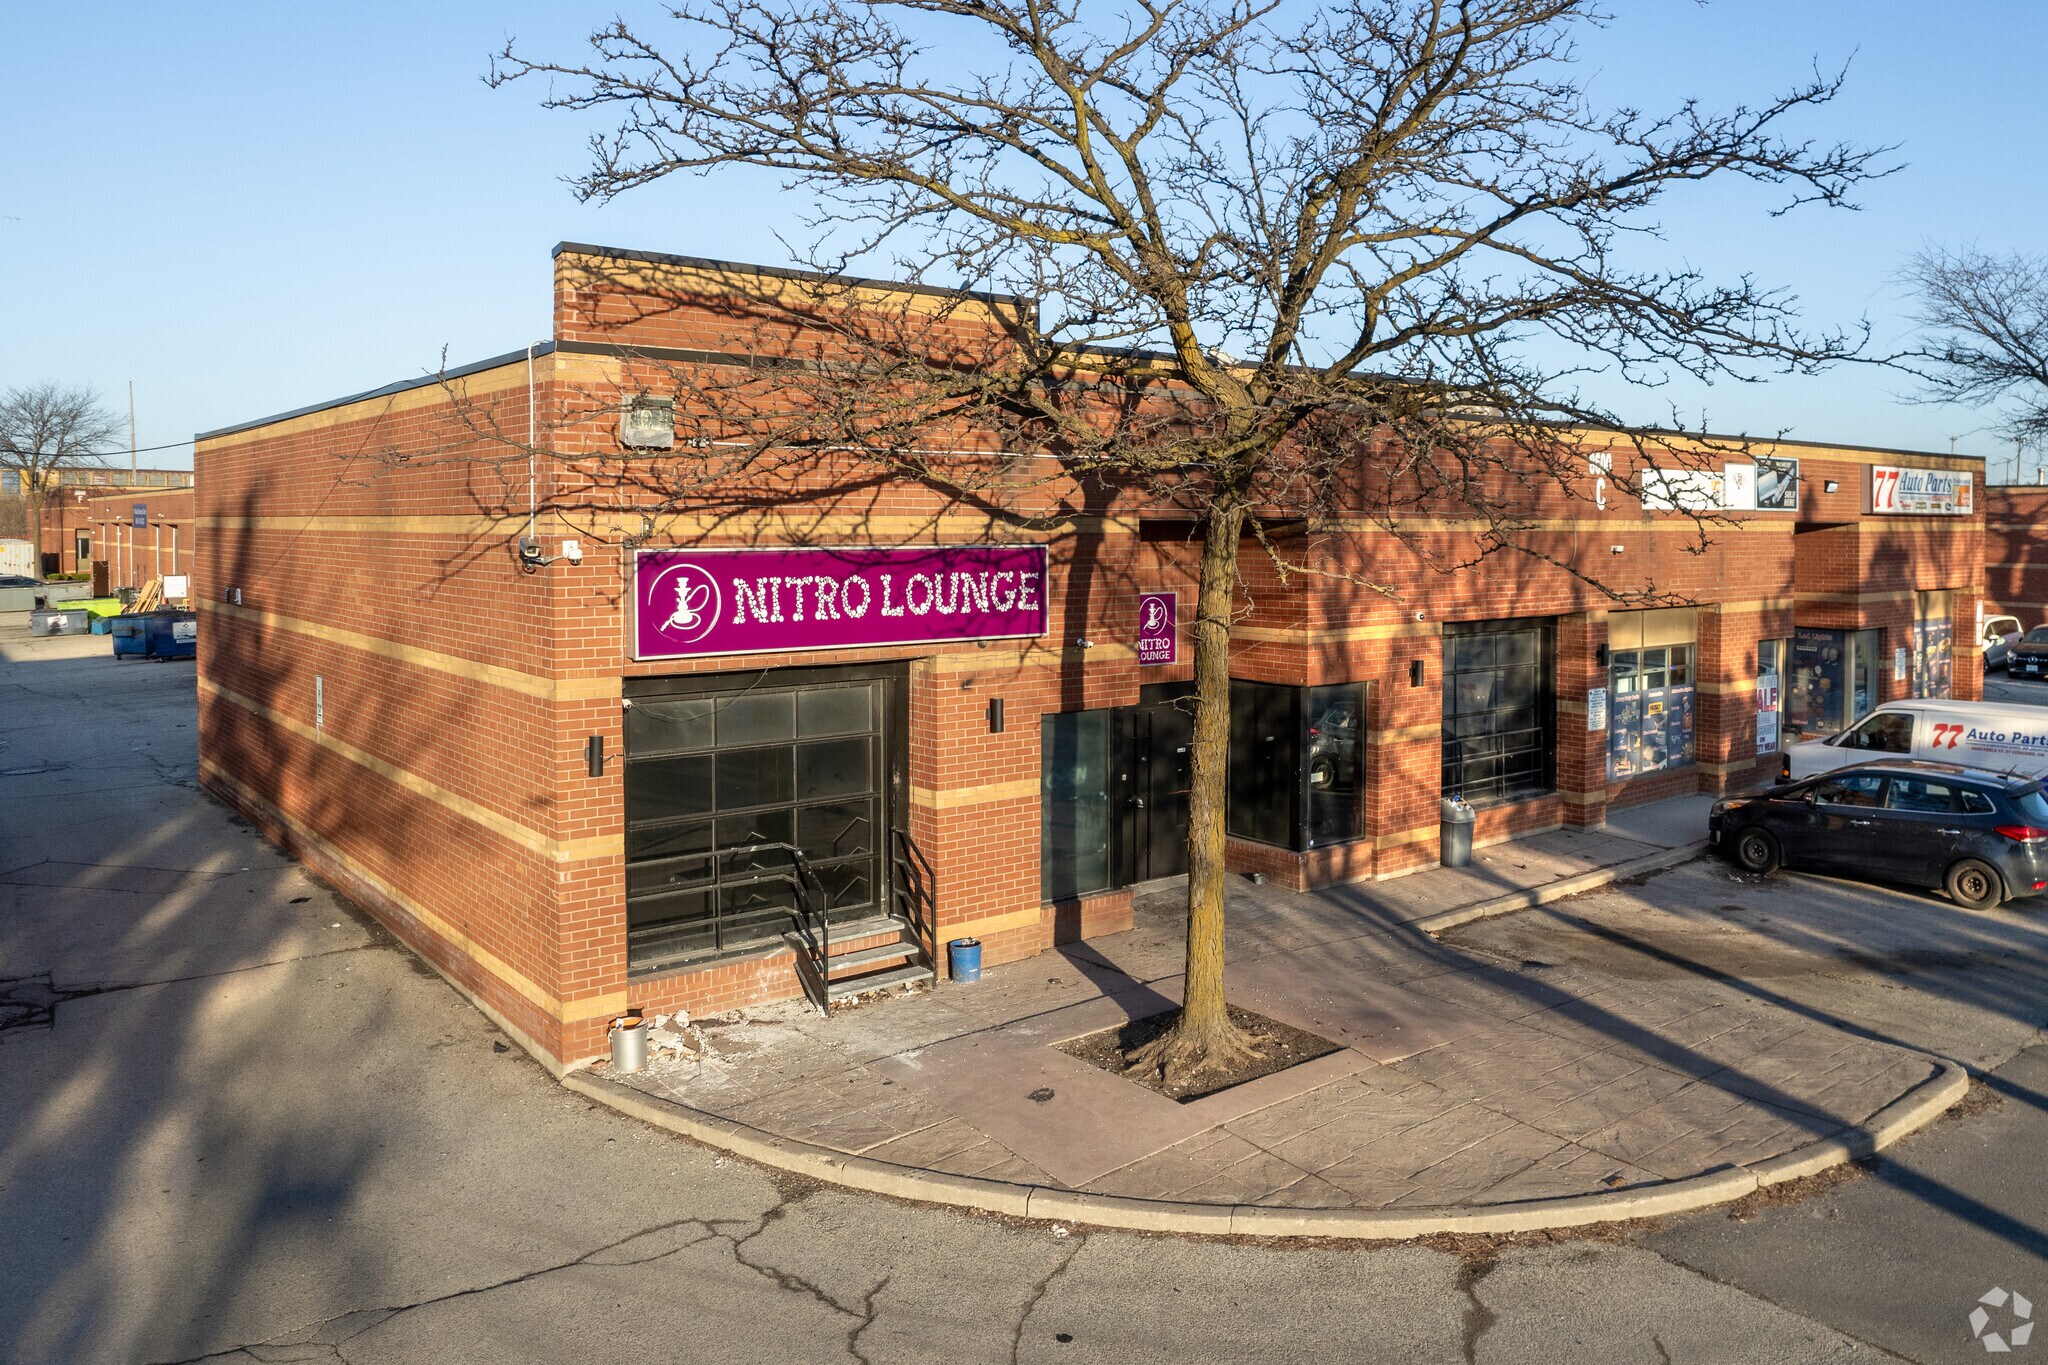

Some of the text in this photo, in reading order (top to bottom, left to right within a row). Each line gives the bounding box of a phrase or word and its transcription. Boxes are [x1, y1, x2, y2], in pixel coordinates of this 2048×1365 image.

[1596, 477, 1606, 510] C
[1875, 470, 1899, 508] 77
[1899, 472, 1923, 492] Auto
[1925, 473, 1952, 493] Parts
[733, 570, 1039, 624] NITRO LOUNGE
[1139, 651, 1171, 661] OUNGE
[1757, 687, 1777, 712] ALE
[1932, 723, 1964, 750] 77
[1966, 728, 2006, 742] Auto
